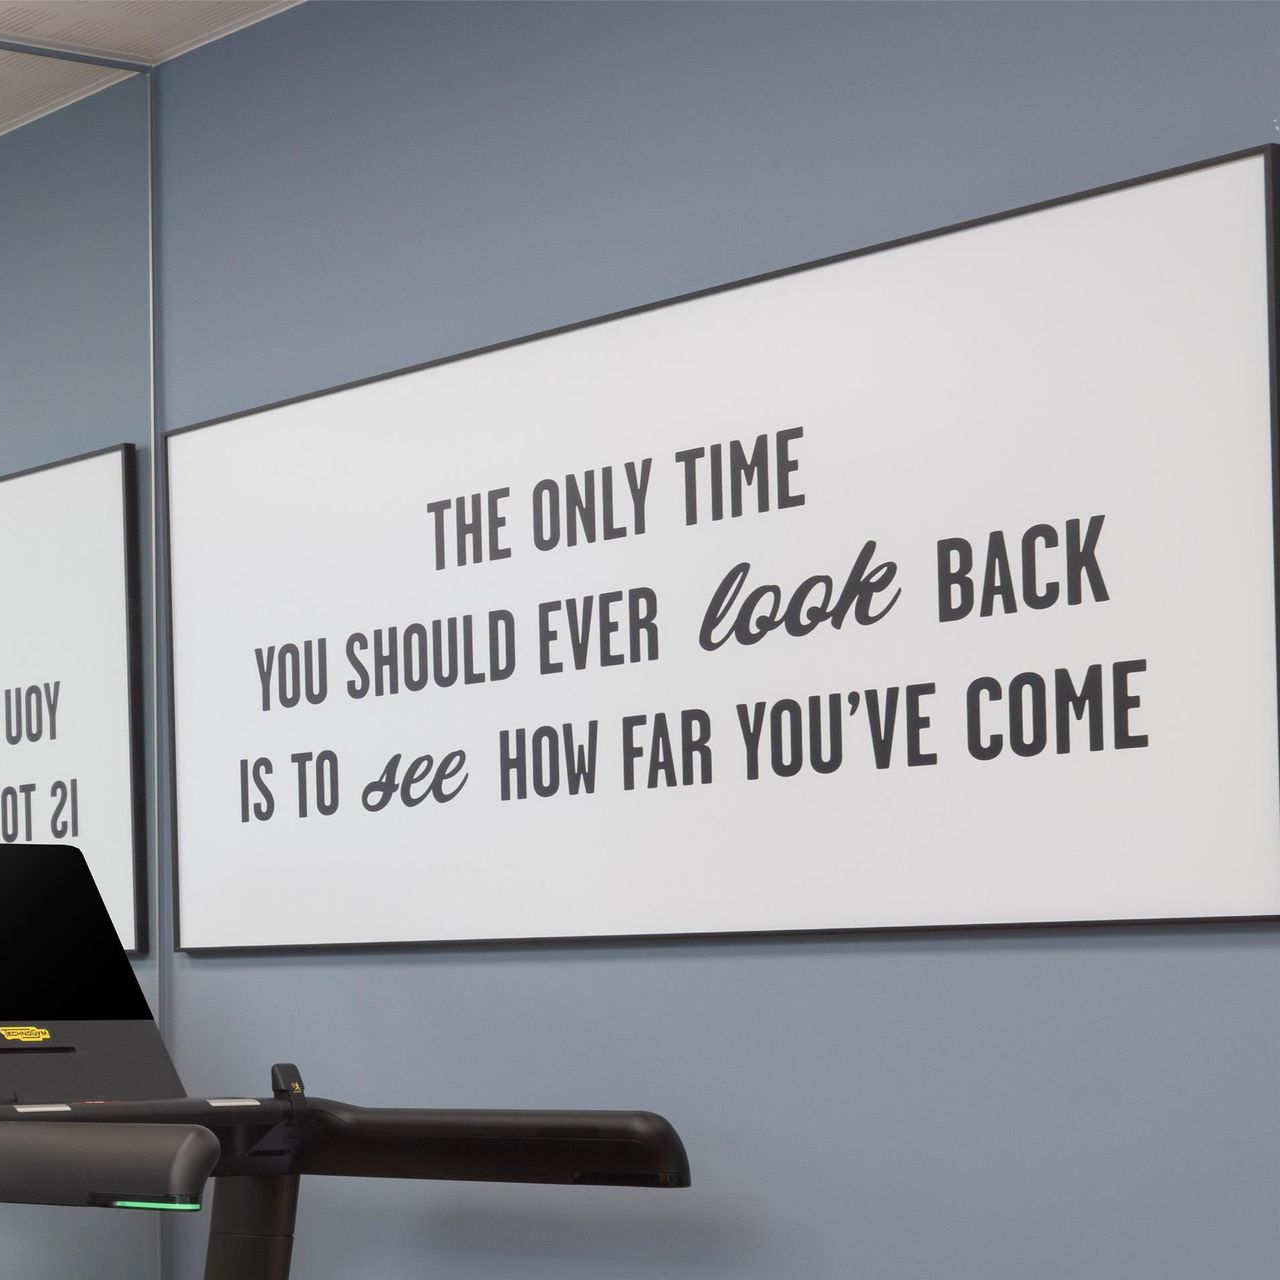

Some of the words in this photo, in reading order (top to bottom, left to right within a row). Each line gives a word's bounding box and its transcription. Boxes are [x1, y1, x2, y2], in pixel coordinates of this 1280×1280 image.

[426, 486, 512, 571] THE
[532, 457, 653, 552] ONLY
[675, 426, 806, 526] TIME
[254, 637, 328, 712] YOU
[345, 609, 516, 700] SHOULD
[538, 586, 659, 675] EVER
[698, 540, 902, 652] look
[936, 514, 1110, 623] BACK
[240, 757, 275, 823] IS
[290, 749, 339, 818] TO
[361, 749, 469, 813] see
[499, 719, 598, 801] HOW
[622, 708, 713, 791] FAR
[735, 682, 938, 781] YOU'VE
[966, 658, 1149, 761] COME
